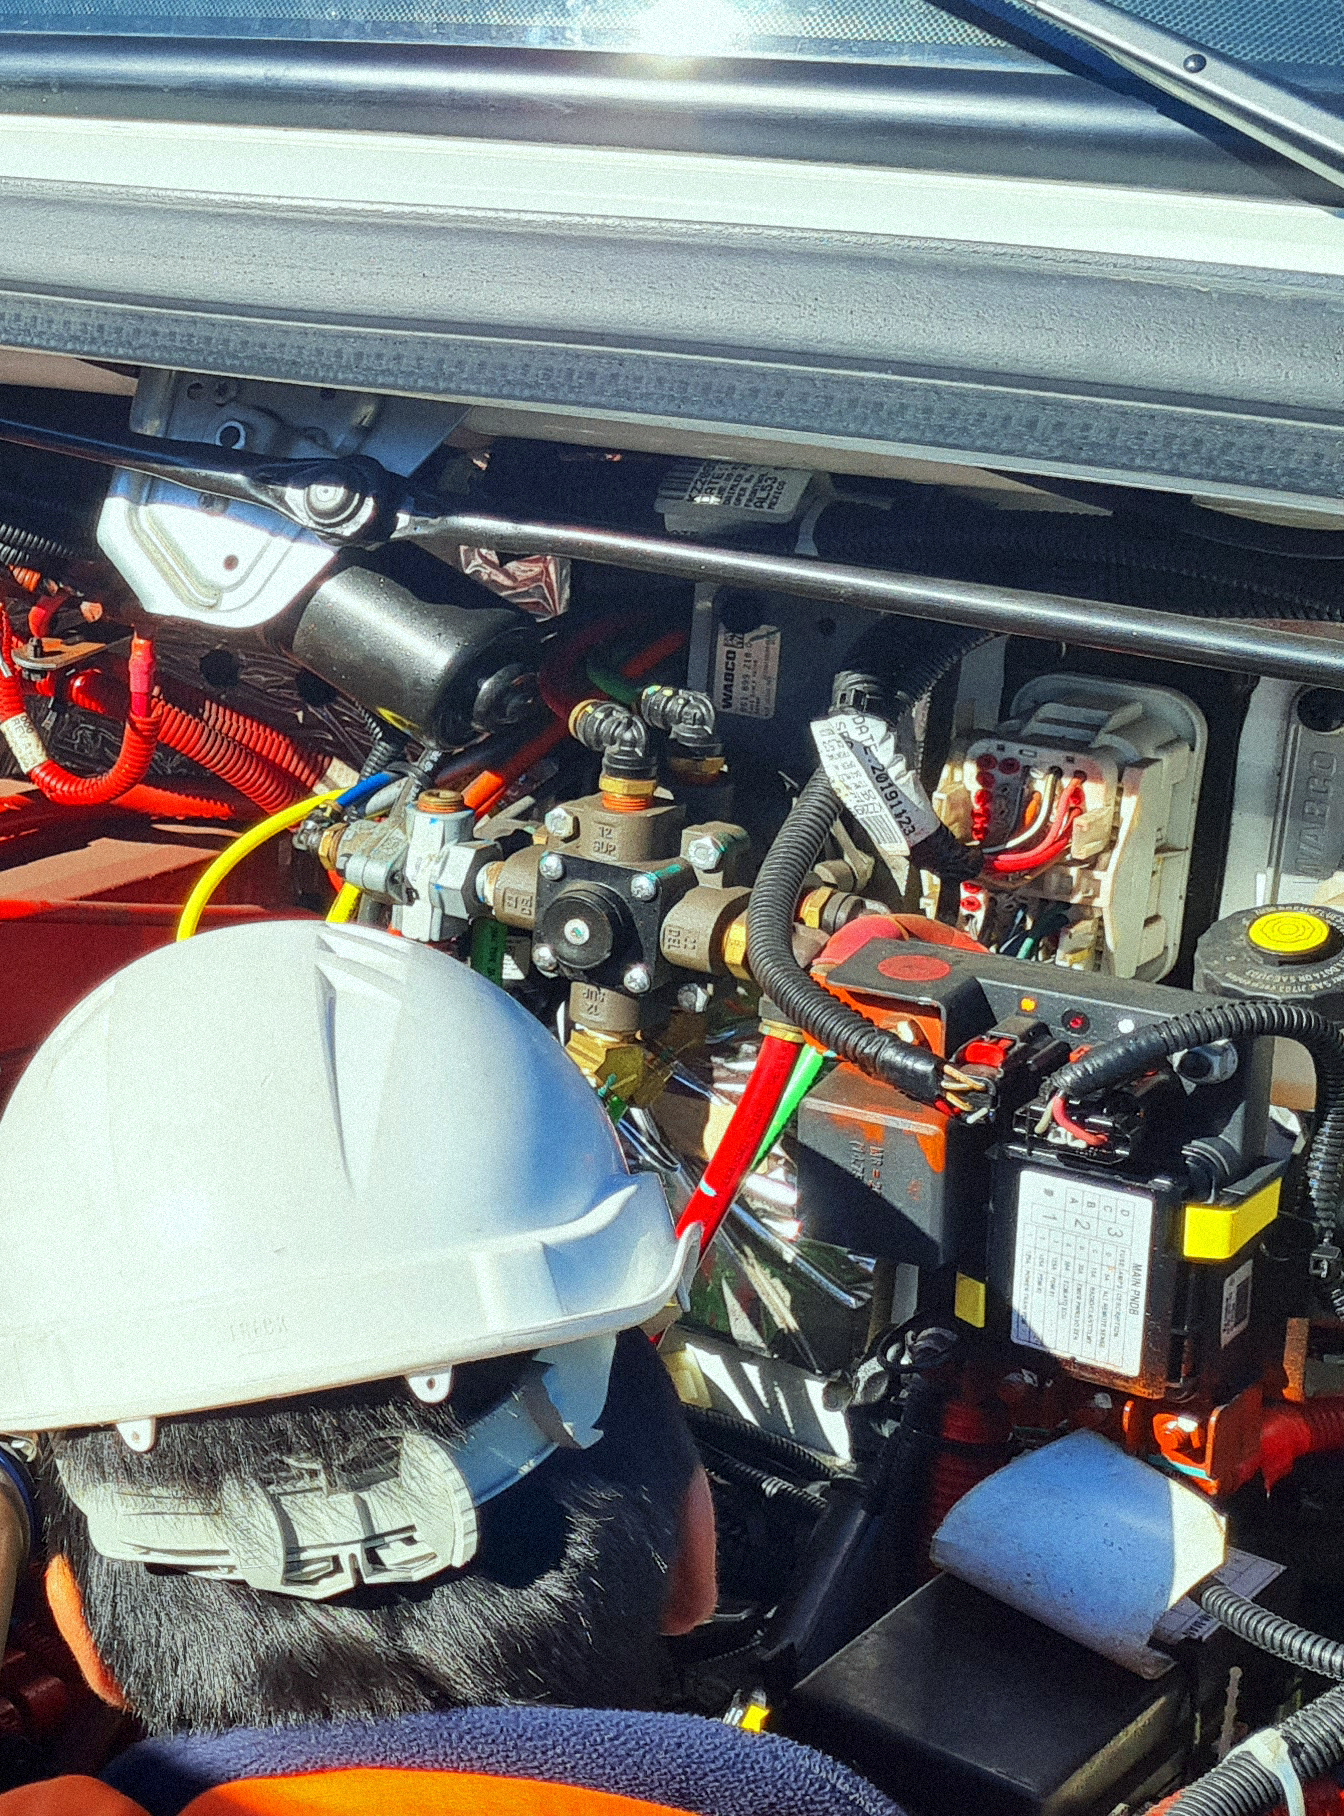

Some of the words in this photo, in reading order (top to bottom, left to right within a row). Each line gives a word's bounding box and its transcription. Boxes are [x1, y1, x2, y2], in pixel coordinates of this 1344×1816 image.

[1292, 750, 1337, 884] WABCO
[1102, 1204, 1112, 1212] C
[1120, 1208, 1129, 1216] D
[1041, 1213, 1056, 1221] 1
[1073, 1218, 1090, 1230] 2
[1106, 1226, 1123, 1238] 3
[1130, 1263, 1142, 1286] MAIN
